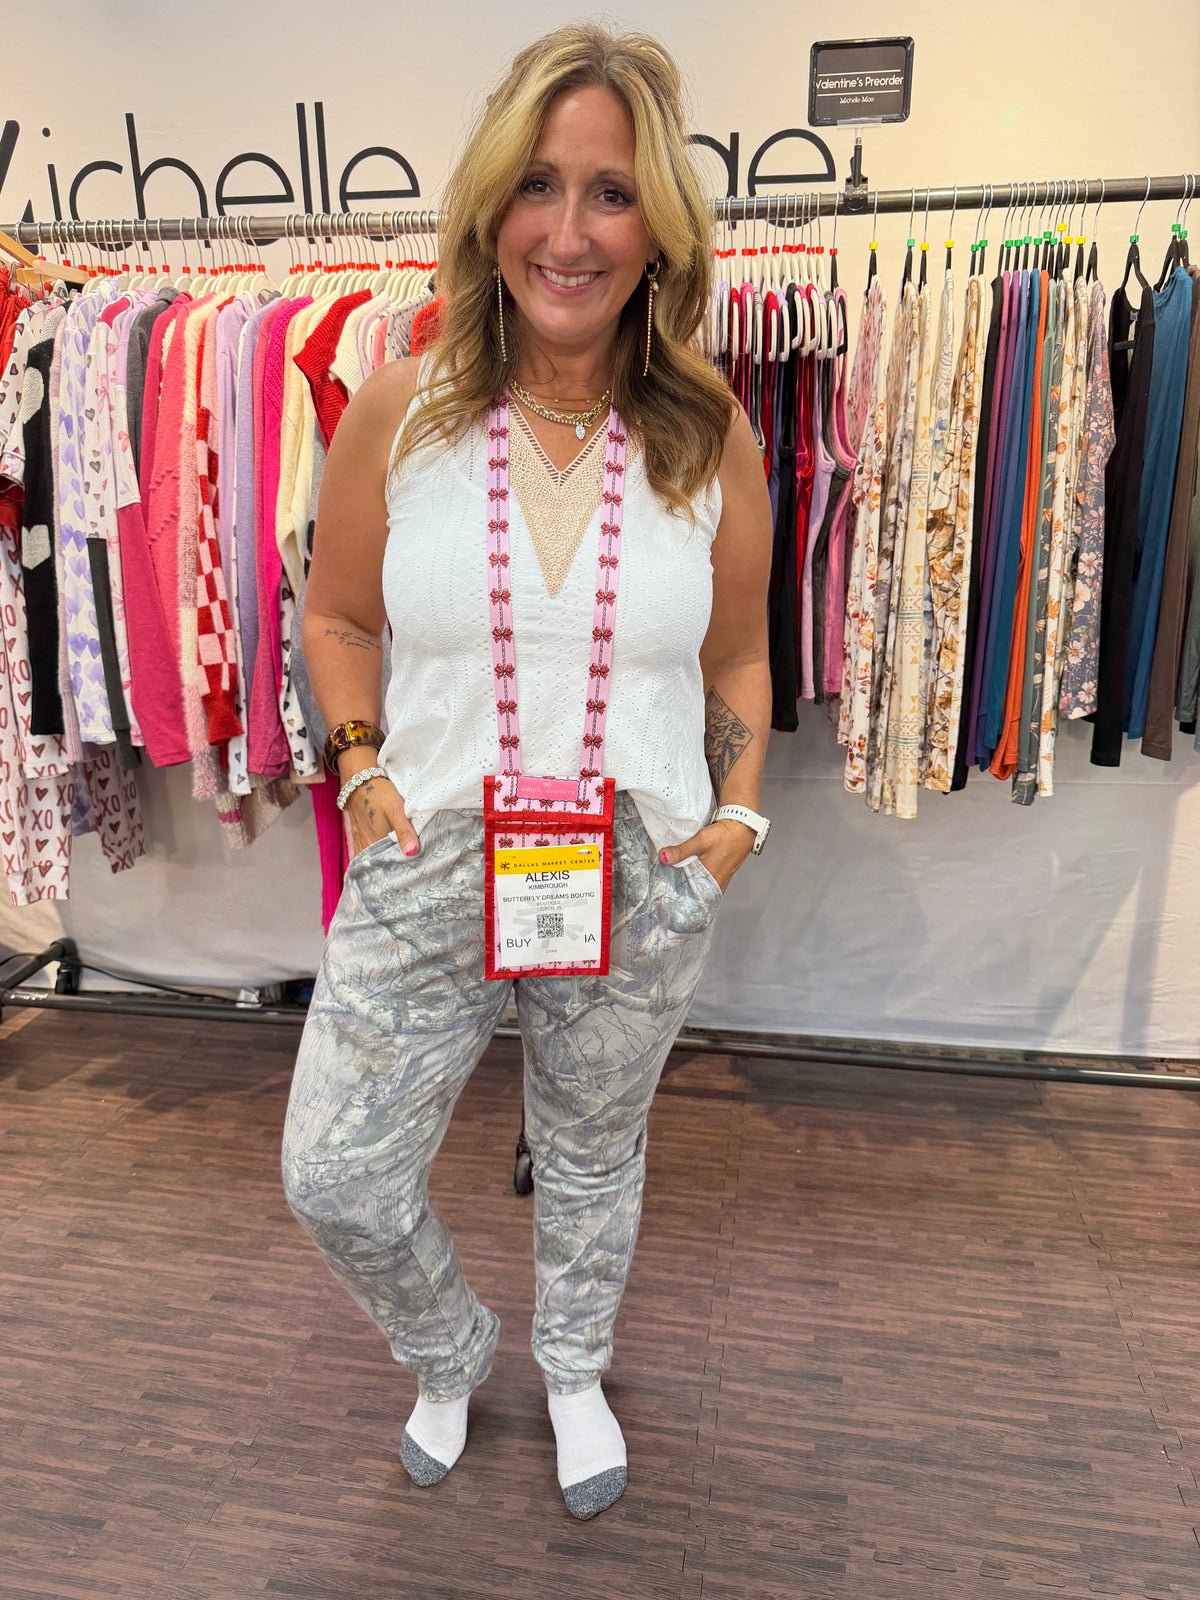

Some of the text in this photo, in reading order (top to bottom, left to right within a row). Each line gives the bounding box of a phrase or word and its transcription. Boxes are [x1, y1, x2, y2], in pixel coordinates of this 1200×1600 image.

[815, 74, 904, 89] Valentine's Preorder
[525, 870, 570, 882] ALEXIS
[528, 882, 569, 890] KIMBROUGH
[502, 895, 541, 903] BUTTERFLY
[541, 893, 569, 901] DREAMS
[506, 933, 596, 948] BUY IA
